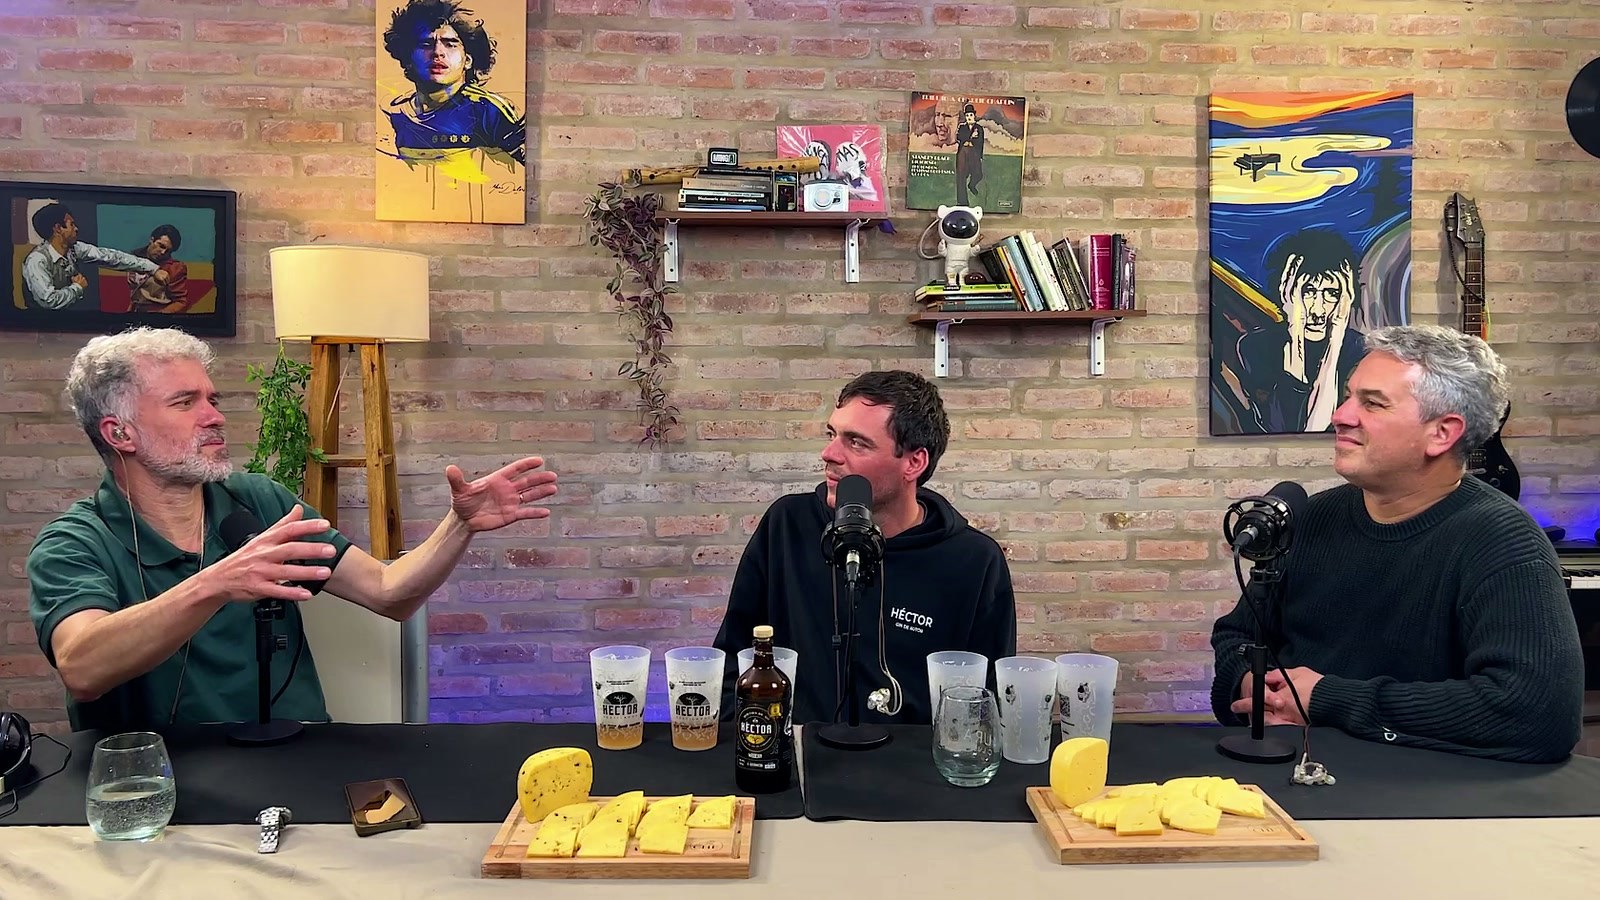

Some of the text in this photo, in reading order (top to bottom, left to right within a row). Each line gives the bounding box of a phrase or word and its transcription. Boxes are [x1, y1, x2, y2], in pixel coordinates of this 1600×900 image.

[987, 97, 1015, 106] CHAPLIN
[890, 607, 933, 628] HÉCTOR
[602, 703, 638, 716] HECTOR
[675, 704, 711, 717] HECTOR
